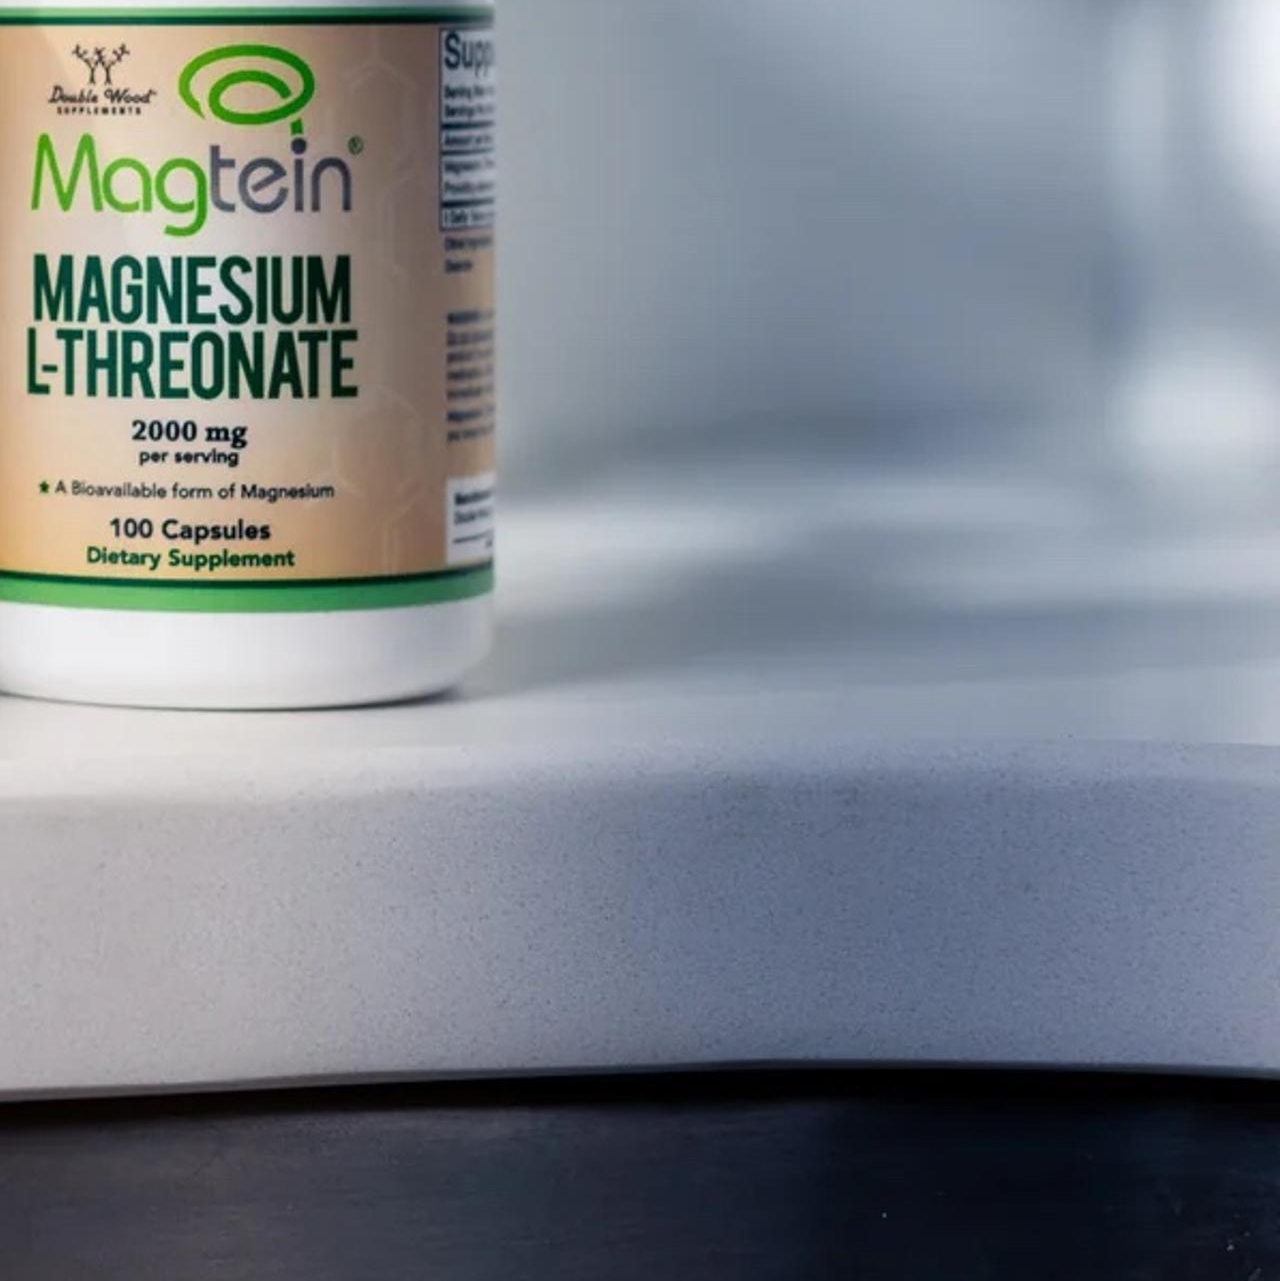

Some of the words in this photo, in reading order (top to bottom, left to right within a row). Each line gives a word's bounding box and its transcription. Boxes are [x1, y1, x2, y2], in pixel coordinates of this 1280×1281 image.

[57, 107, 141, 115] SUPPLEMENTS
[33, 253, 351, 324] MAGNESIUM
[27, 328, 358, 400] L-THREONATE
[132, 420, 197, 441] 2000
[205, 423, 248, 448] mg
[139, 451, 168, 466] per
[174, 449, 239, 467] serving
[55, 481, 67, 495] A
[71, 480, 167, 499] Bioavailable
[172, 482, 212, 499] form
[217, 482, 236, 499] of
[241, 483, 335, 502] Magnesium
[110, 518, 153, 539] 100
[162, 519, 272, 545] Capsules
[87, 546, 161, 568] Dietary
[168, 548, 295, 571] Supplement
